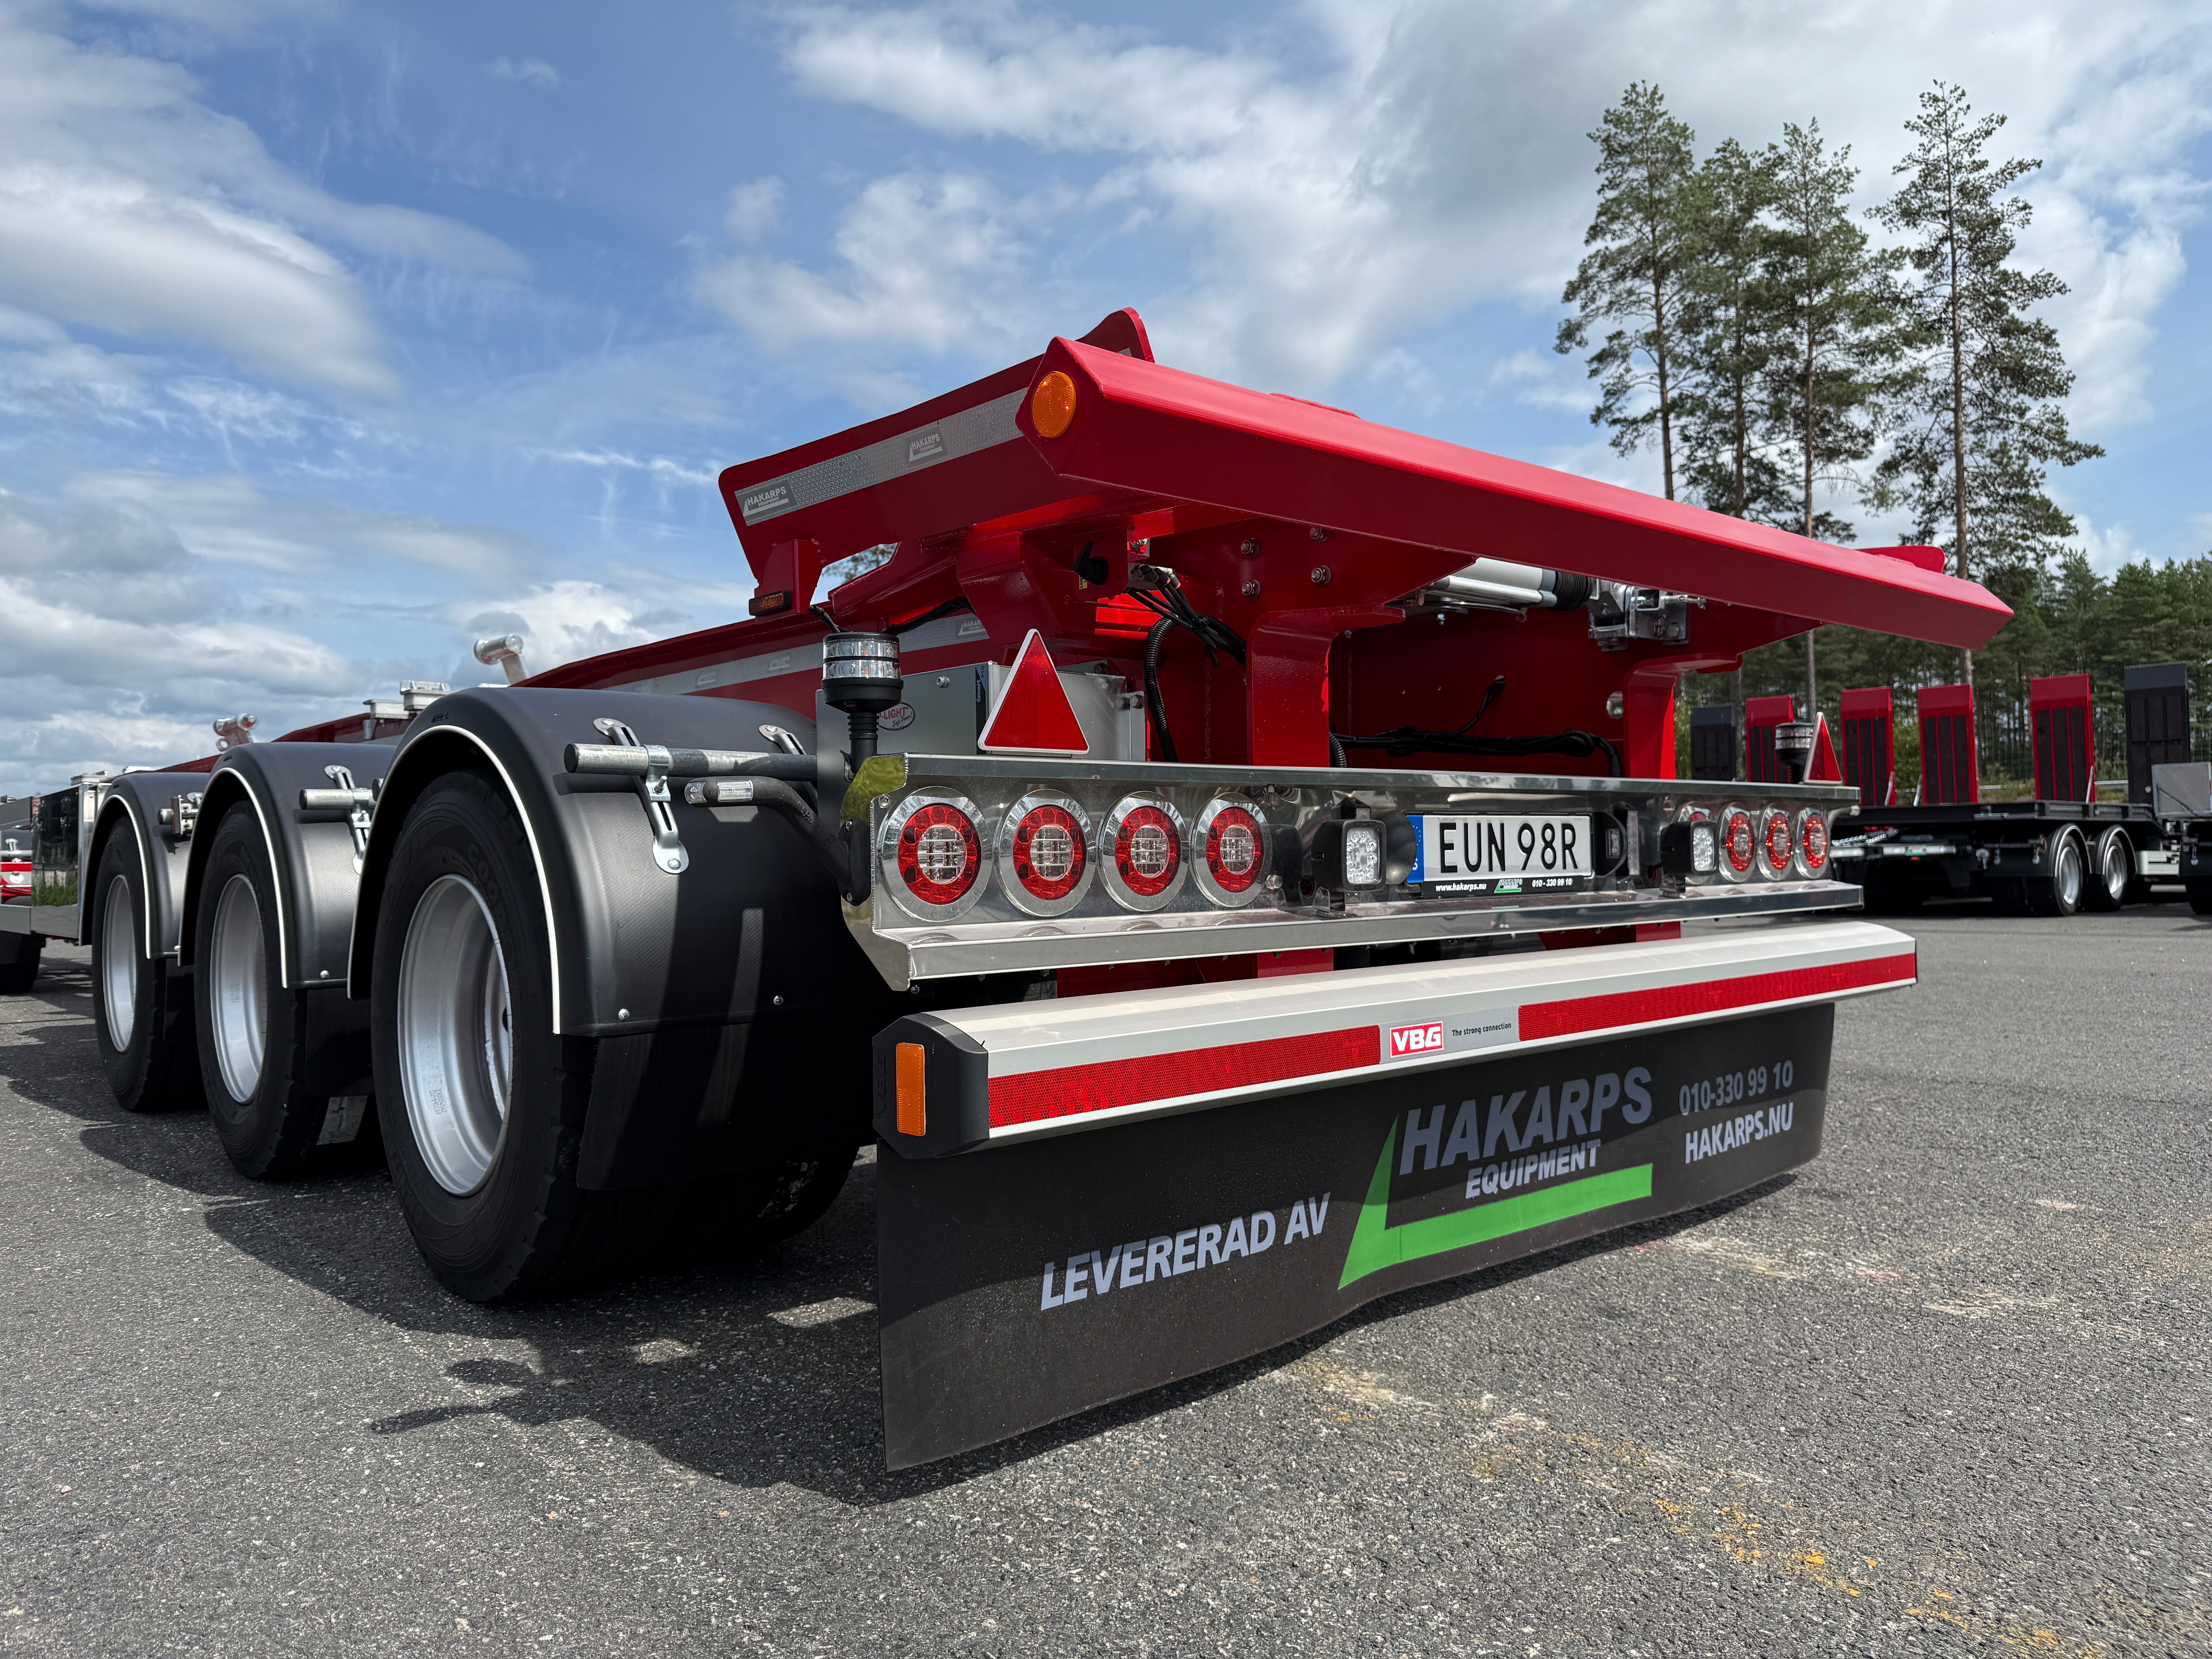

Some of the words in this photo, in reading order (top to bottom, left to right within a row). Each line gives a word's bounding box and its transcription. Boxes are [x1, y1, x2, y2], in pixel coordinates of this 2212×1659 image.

[911, 434, 940, 450] HAKARPS
[747, 487, 786, 506] HAKARPS
[1440, 822, 1506, 873] EUN
[1518, 823, 1578, 871] 98R
[1436, 883, 1486, 891] www.hakarps.nu
[1393, 1026, 1441, 1051] VBG
[1483, 1022, 1511, 1032] connection
[1679, 1072, 1743, 1116] 010-330
[1748, 1066, 1767, 1097] 99
[1773, 1060, 1793, 1090] 10
[1399, 1066, 1652, 1176] HAKARPS
[1685, 1101, 1793, 1164] HAKARPS.NU
[1465, 1139, 1601, 1199] EQUIPMENT
[1041, 1211, 1276, 1310] LEVERERAD
[1284, 1192, 1331, 1245] AV
